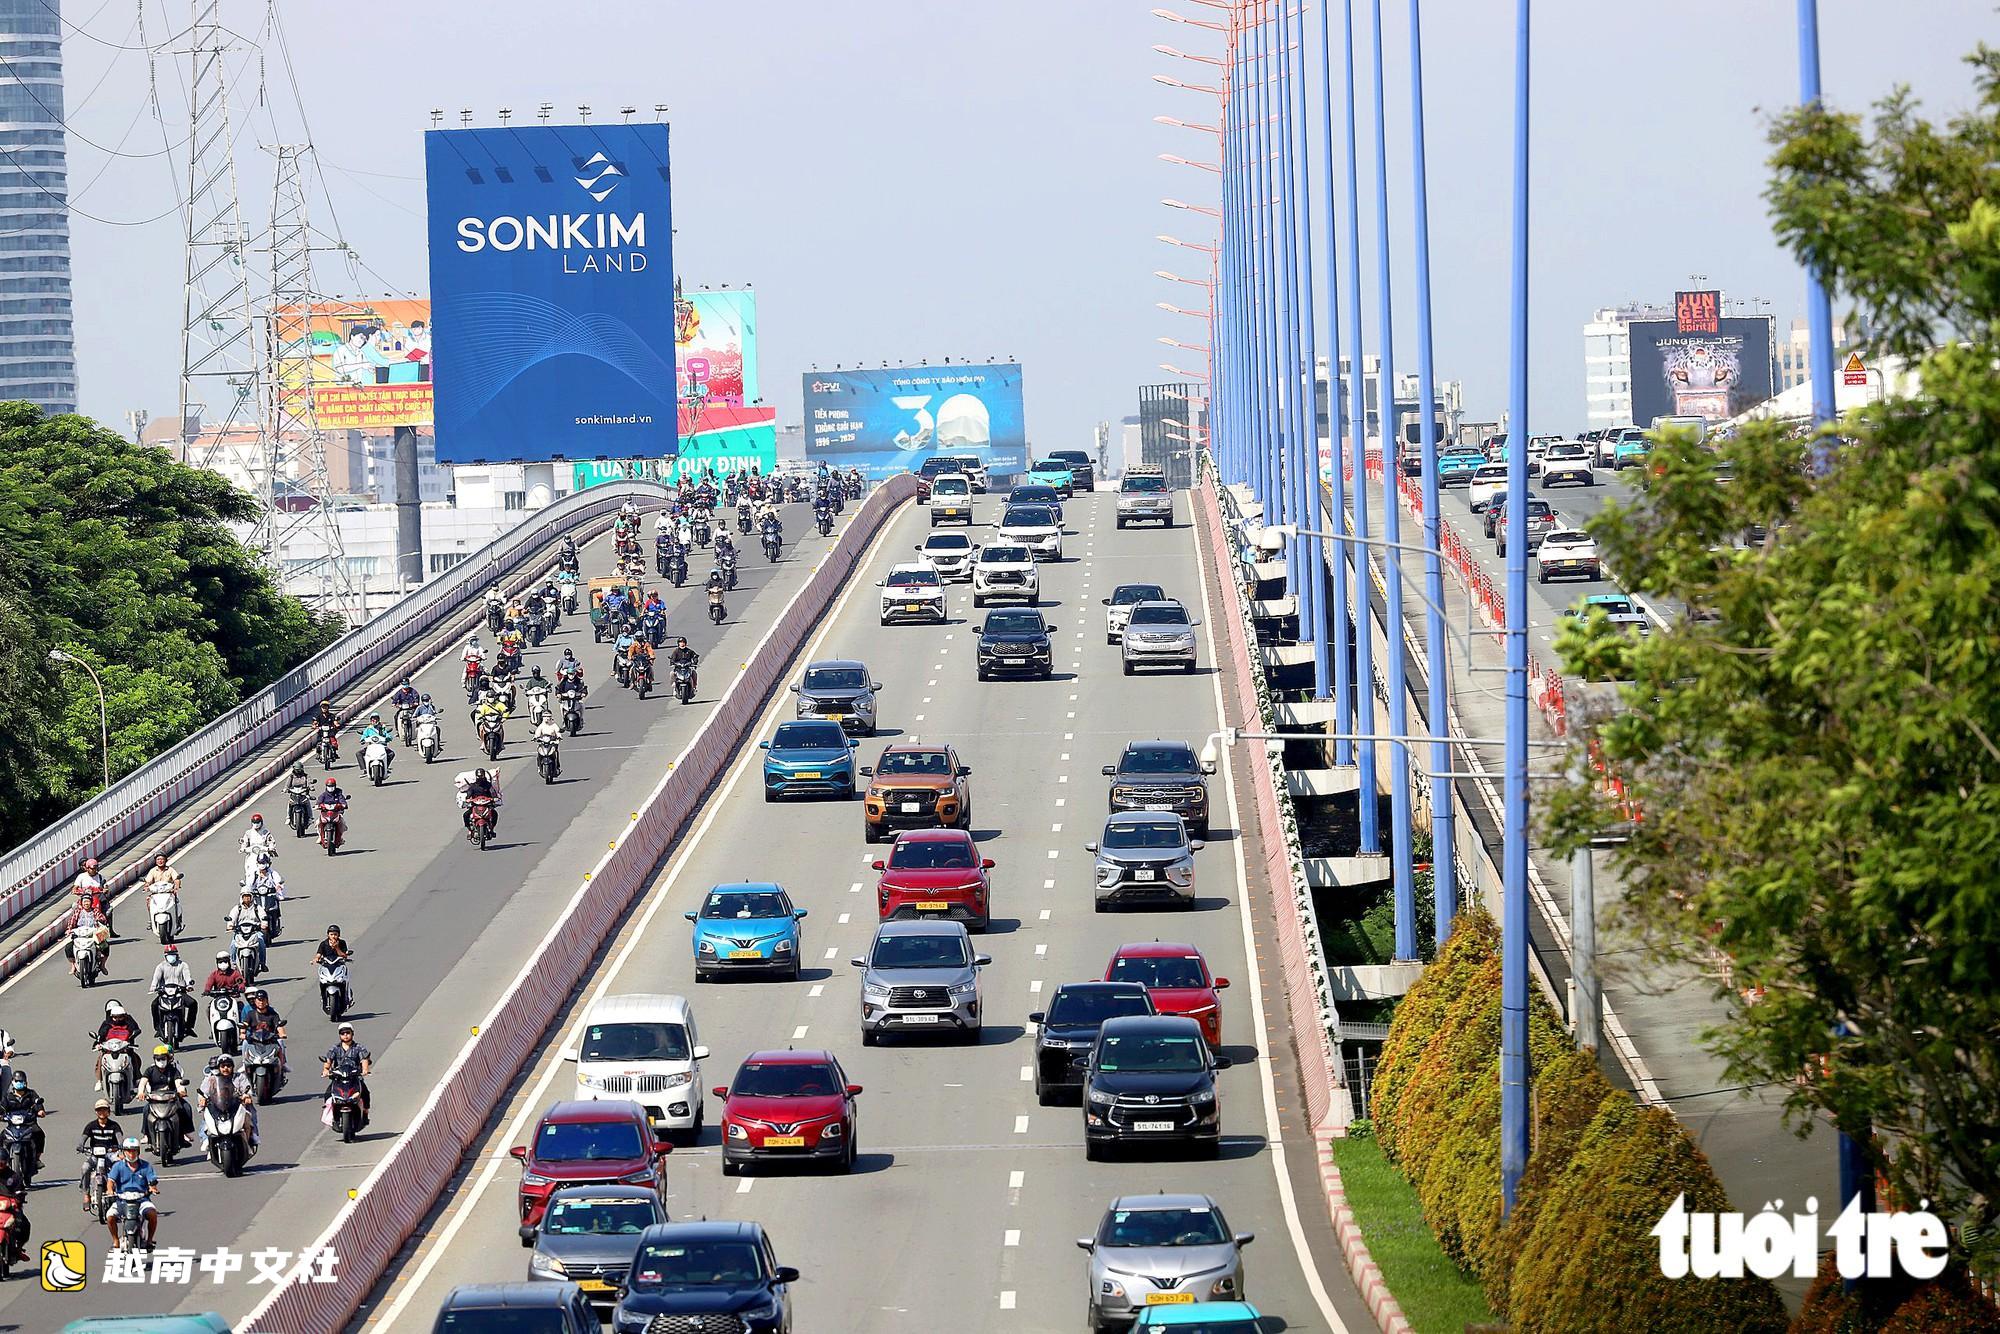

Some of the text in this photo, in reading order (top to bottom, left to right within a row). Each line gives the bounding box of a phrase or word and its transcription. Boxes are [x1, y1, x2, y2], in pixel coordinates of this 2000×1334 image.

[456, 212, 646, 252] SONKIM
[563, 253, 648, 274] LAND
[575, 414, 653, 425] sonkimland.vn
[677, 456, 712, 475] QUY
